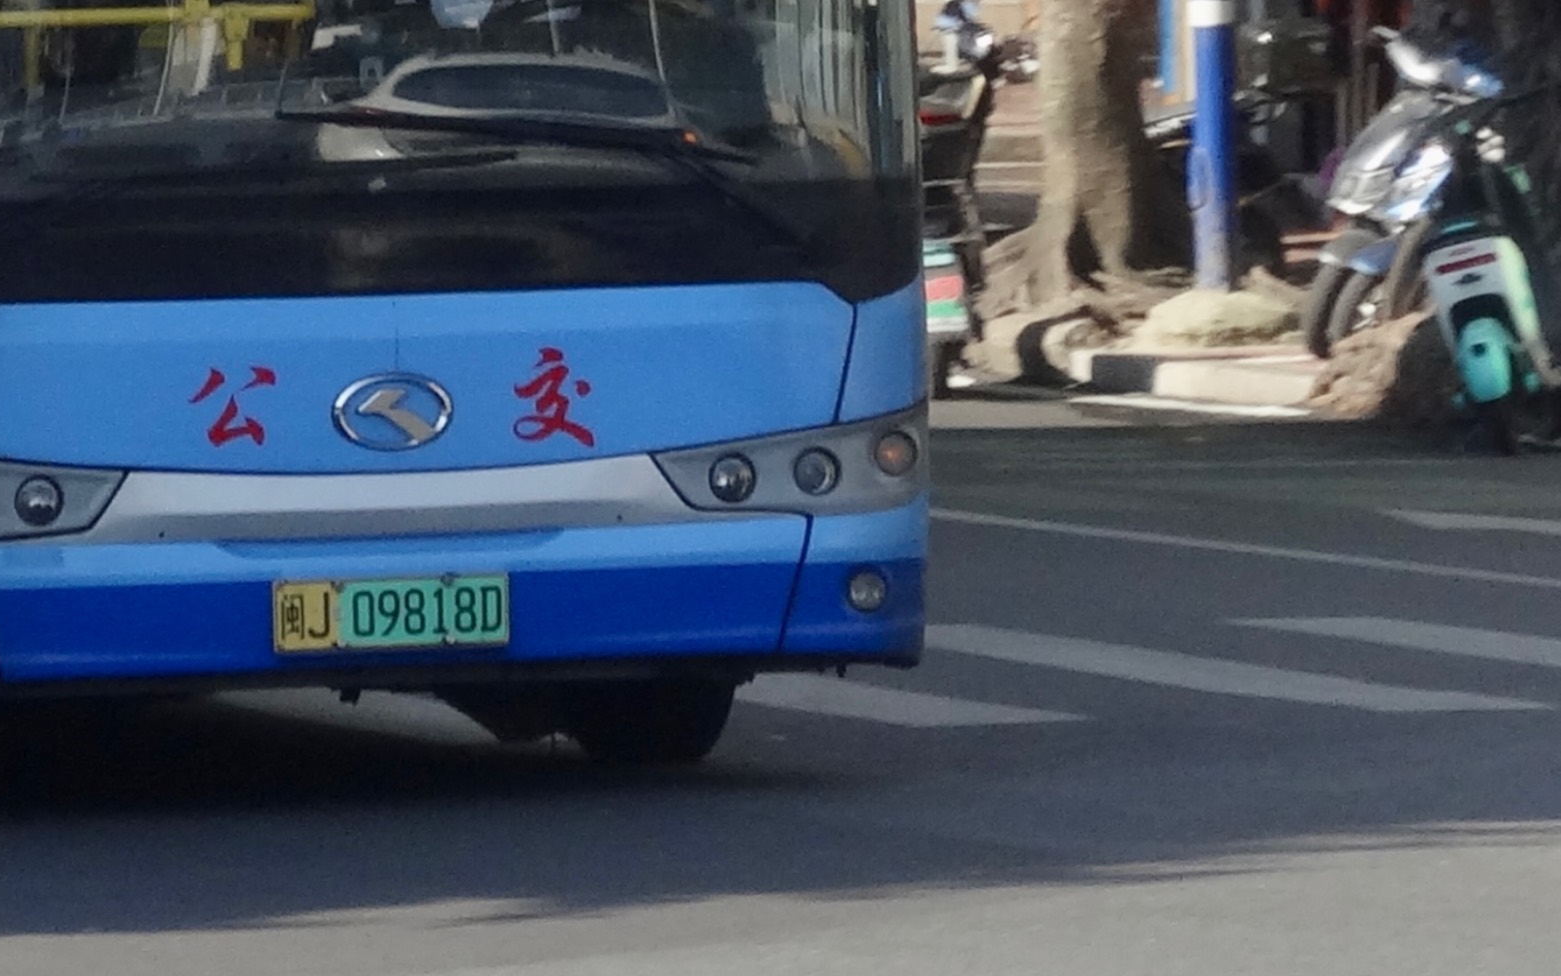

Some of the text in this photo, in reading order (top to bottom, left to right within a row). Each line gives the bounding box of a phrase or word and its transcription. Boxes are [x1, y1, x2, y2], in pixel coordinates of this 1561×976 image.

[189, 347, 595, 448] 公 交
[280, 584, 504, 641] 闽J 09818D
